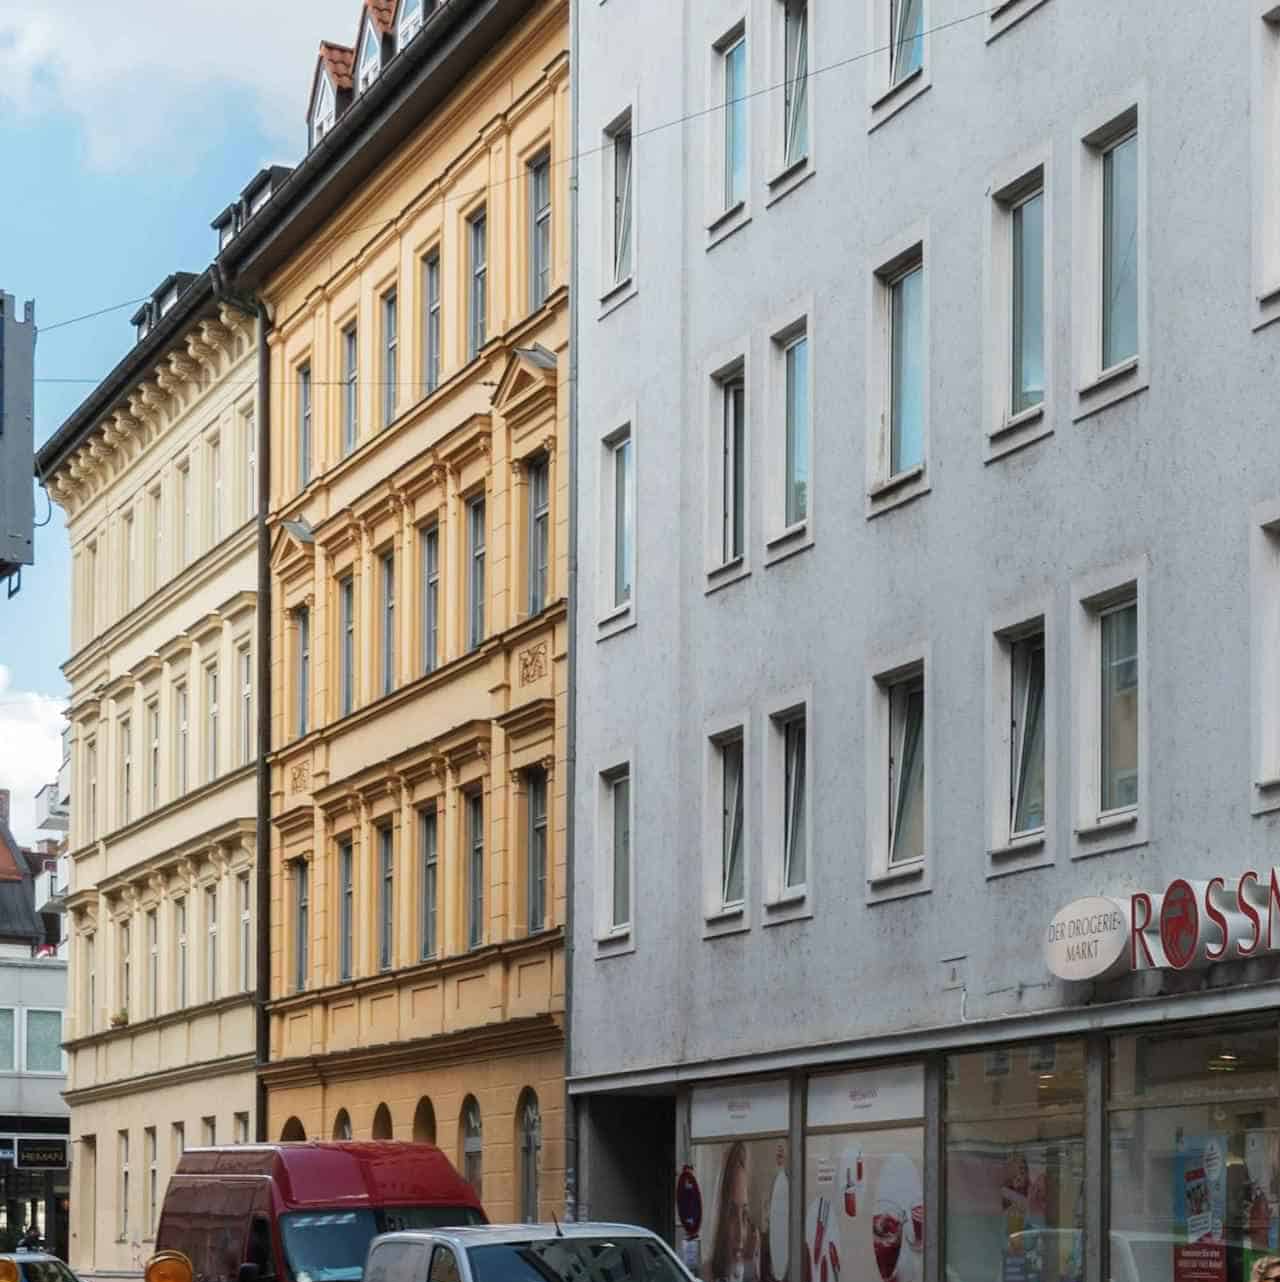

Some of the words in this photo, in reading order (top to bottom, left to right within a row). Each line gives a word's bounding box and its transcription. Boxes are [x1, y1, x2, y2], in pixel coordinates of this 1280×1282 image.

[1048, 919, 1067, 942] DER
[1067, 910, 1122, 939] DROGERIE-
[1065, 940, 1099, 962] MARKT
